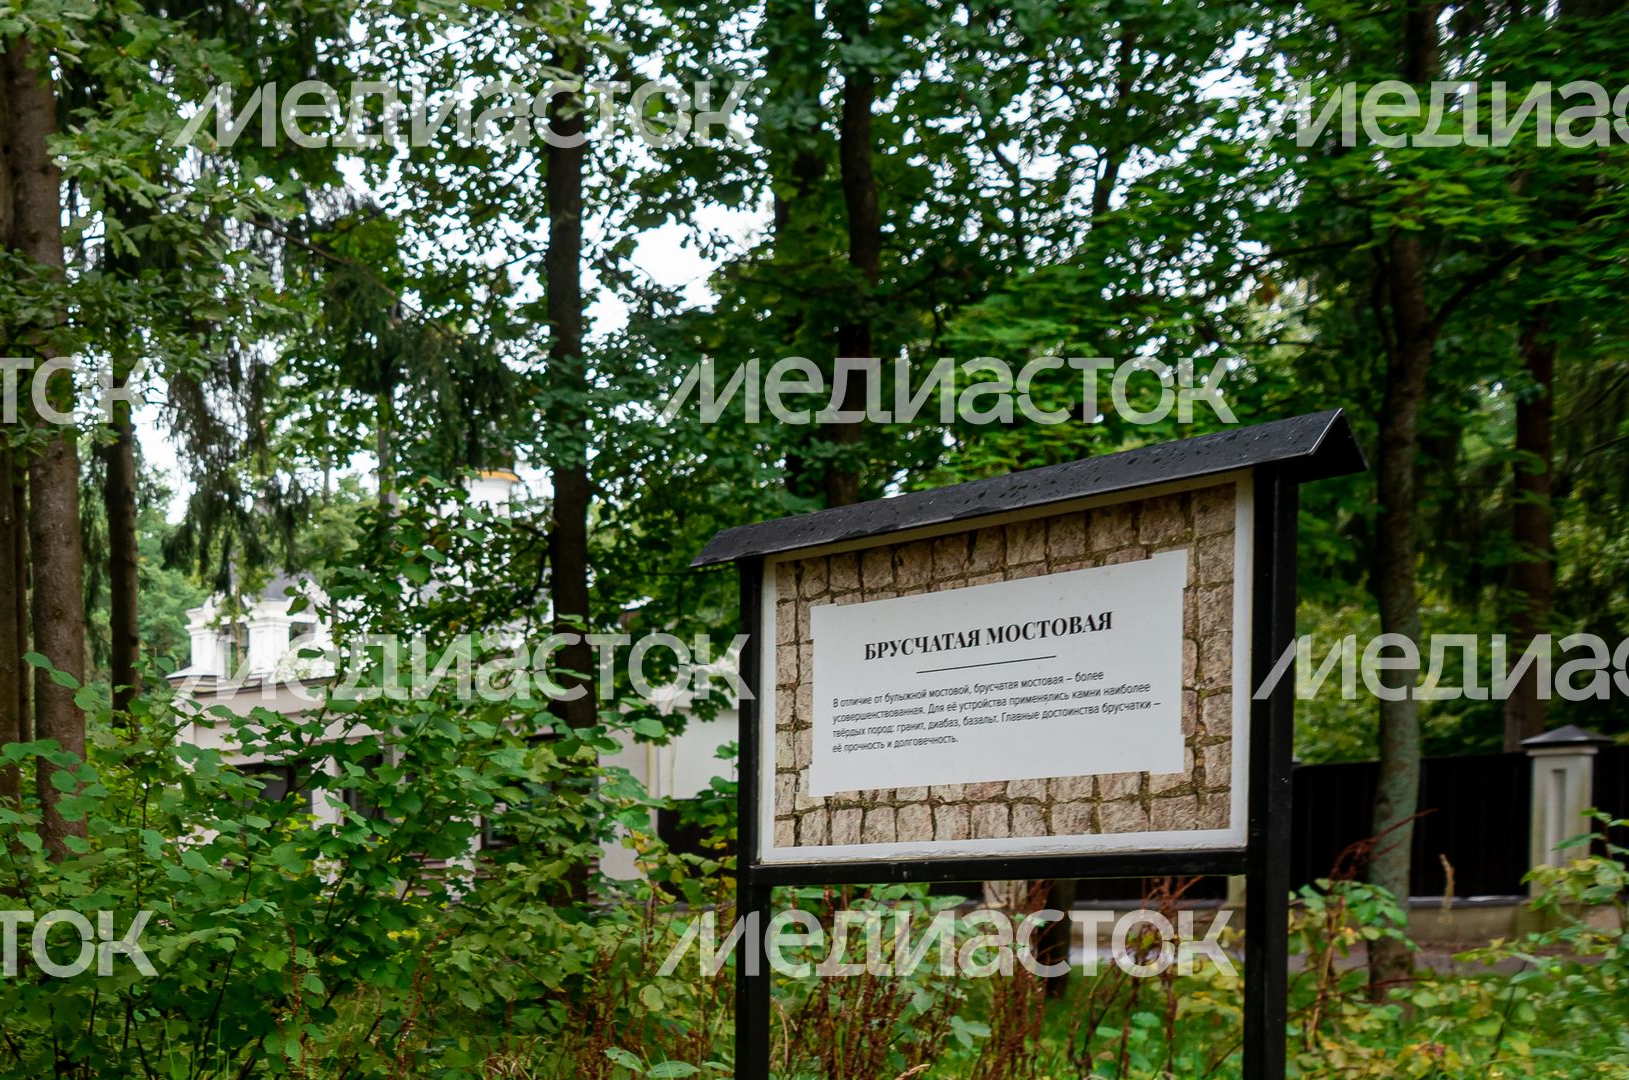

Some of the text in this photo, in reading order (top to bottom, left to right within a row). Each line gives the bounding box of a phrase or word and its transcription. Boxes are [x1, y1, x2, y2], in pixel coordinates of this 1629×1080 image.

[865, 611, 1113, 660] БРУСЧАТАЯ МОСТОВАЯ
[833, 698, 838, 708] В
[840, 697, 872, 707] отличие
[874, 695, 882, 704] от
[885, 689, 926, 704] булыжной
[973, 681, 1018, 694] брусчатая
[1021, 676, 1064, 688] мостовая
[1075, 671, 1104, 682] более
[928, 703, 944, 714] Для
[959, 698, 1007, 713] устройства
[1009, 692, 1069, 707] применялись
[1072, 689, 1101, 699] камни
[1103, 683, 1151, 696] наиболее
[1001, 711, 1040, 722] Главные
[1042, 705, 1099, 720] достоинства
[1102, 700, 1151, 715] брусчатки
[844, 741, 885, 754] прочность
